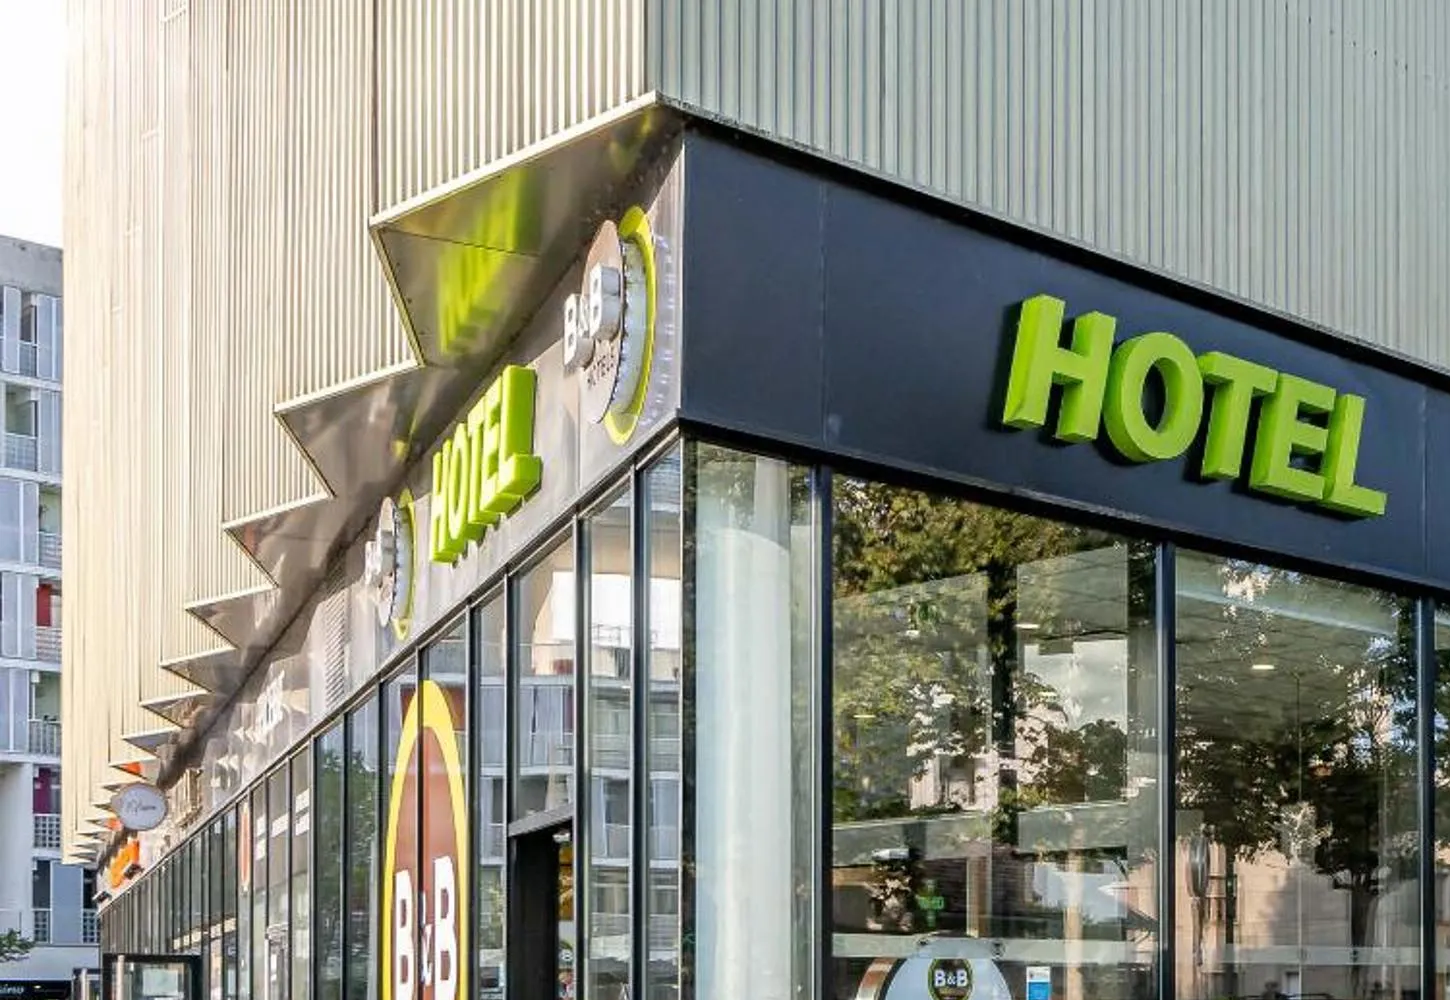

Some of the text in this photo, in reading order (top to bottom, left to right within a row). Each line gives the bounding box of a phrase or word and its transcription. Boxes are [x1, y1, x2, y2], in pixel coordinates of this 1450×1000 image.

[563, 262, 616, 370] B&B
[430, 365, 541, 562] HOTEL
[1002, 293, 1387, 519] HOTEL
[934, 968, 969, 987] B&B
